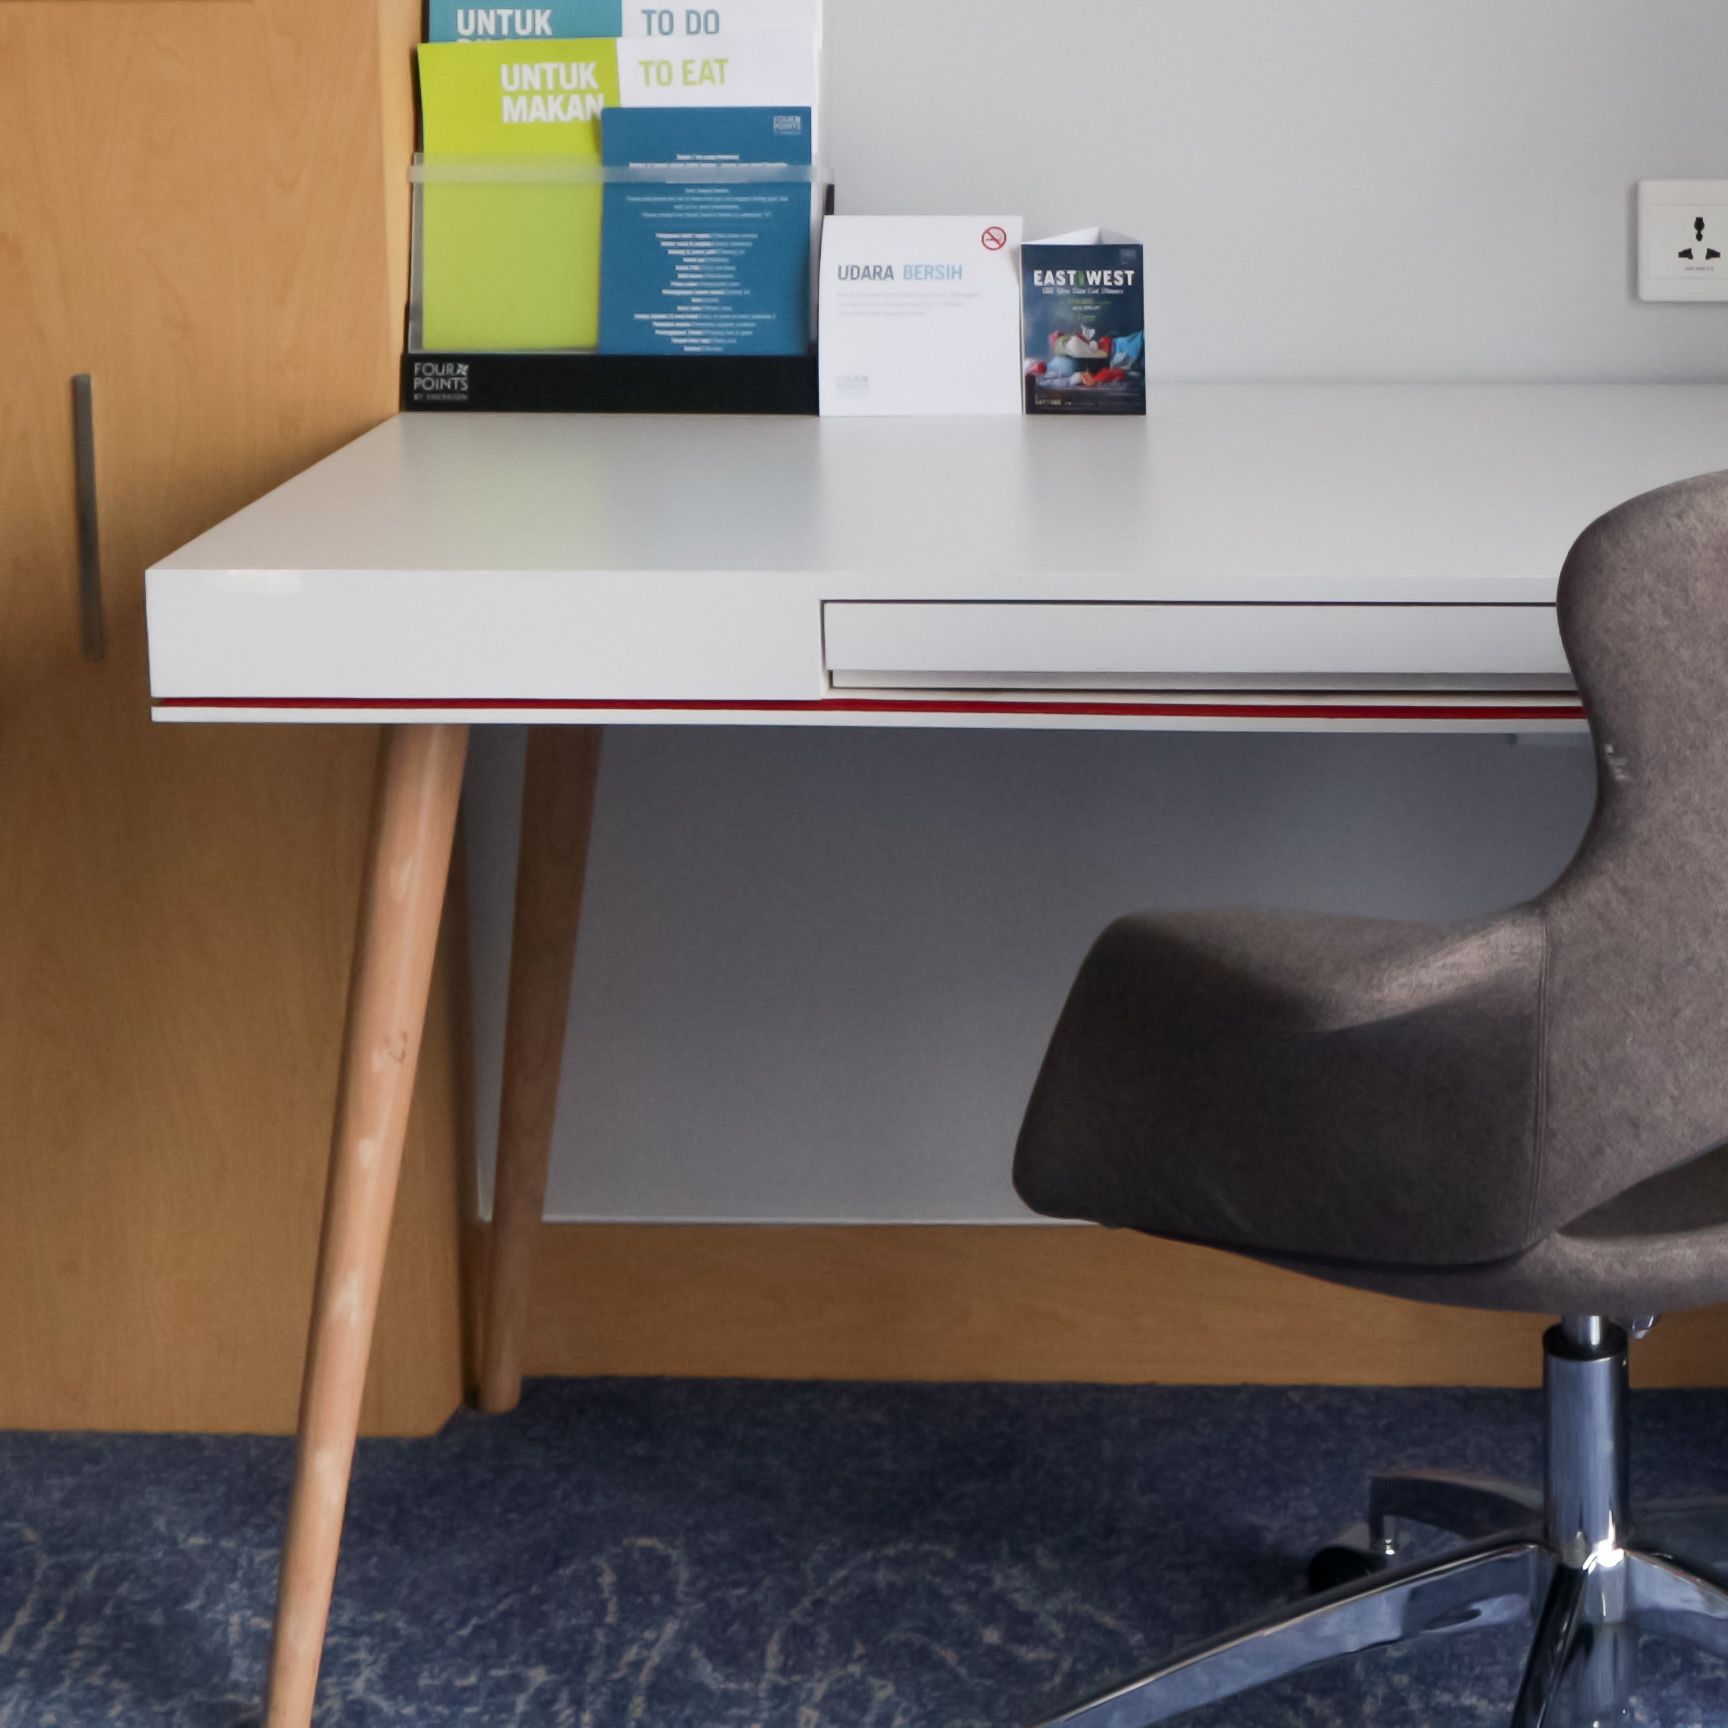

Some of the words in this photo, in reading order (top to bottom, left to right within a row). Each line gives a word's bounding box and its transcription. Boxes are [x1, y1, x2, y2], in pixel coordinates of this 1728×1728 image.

[456, 8, 552, 36] UNTUK
[641, 9, 674, 36] TO
[685, 9, 720, 35] DO
[500, 62, 598, 91] UNTUK
[638, 59, 673, 87] TO
[681, 58, 729, 86] EAT
[502, 93, 605, 123] MAKAN
[837, 264, 894, 281] UDARA
[903, 264, 963, 281] BERSIH
[1033, 270, 1076, 286] EAST
[1085, 270, 1135, 286] WEST
[414, 362, 455, 376] FOUR
[413, 377, 468, 391] POINTS
